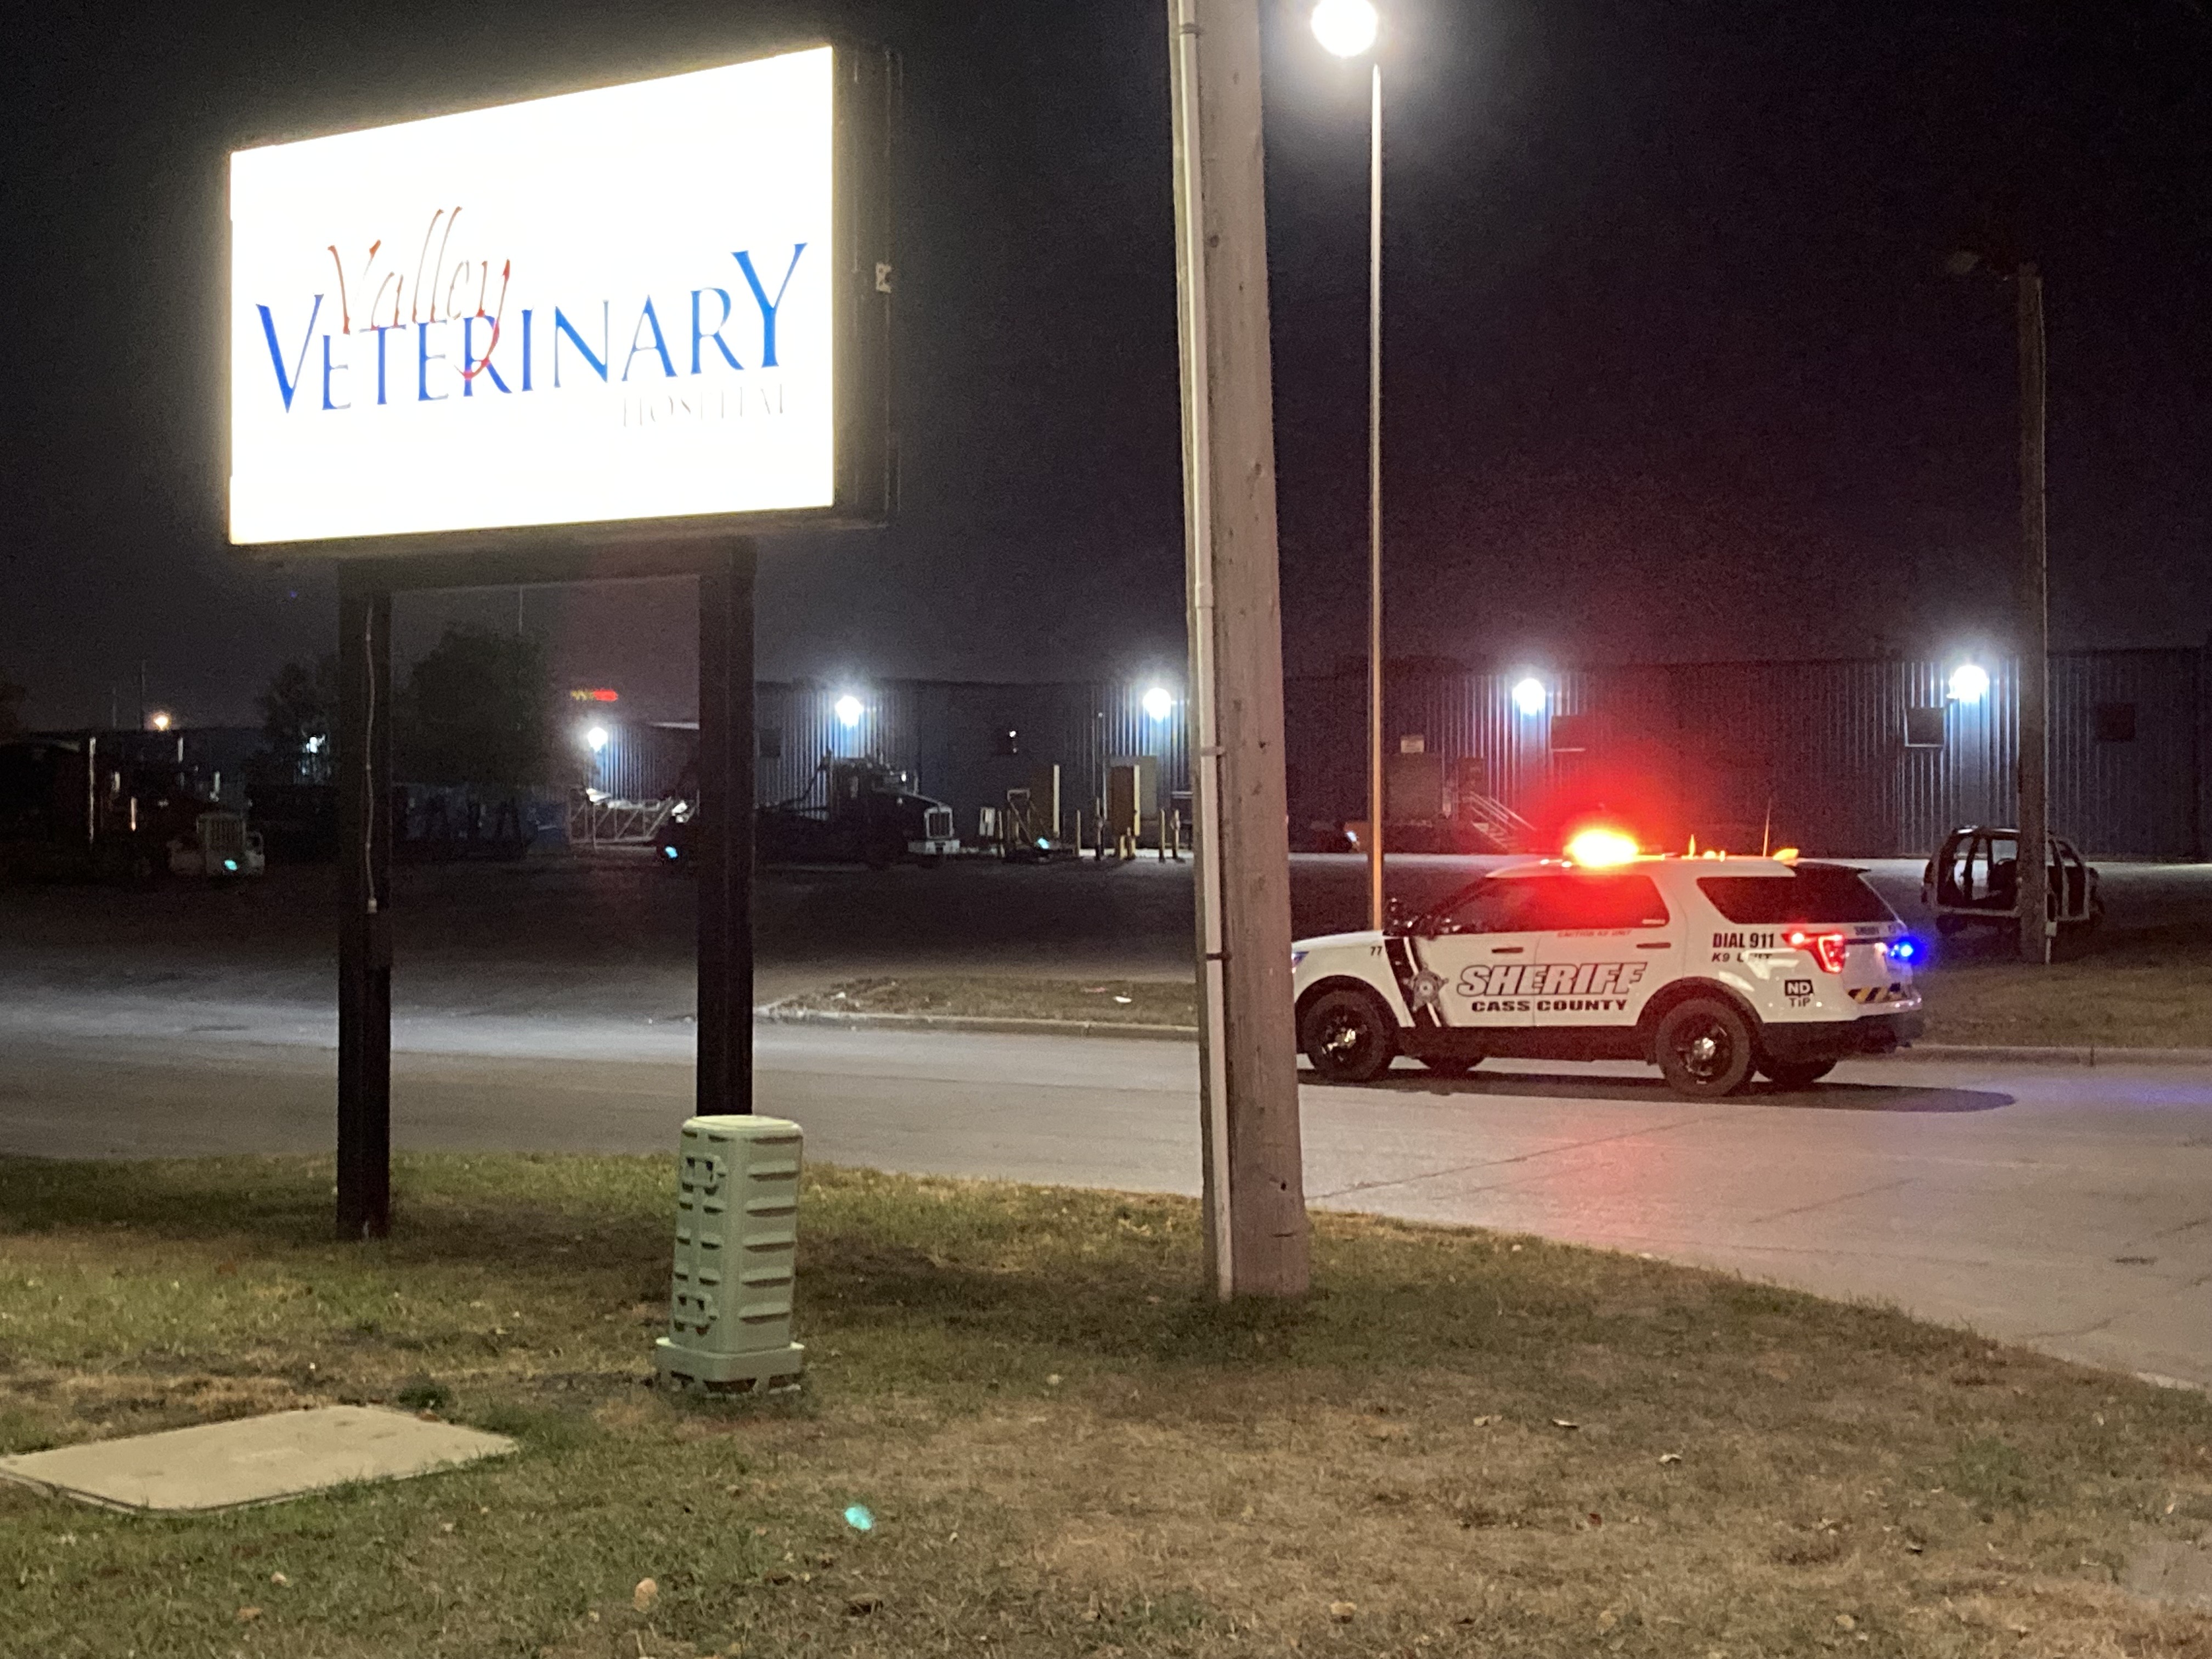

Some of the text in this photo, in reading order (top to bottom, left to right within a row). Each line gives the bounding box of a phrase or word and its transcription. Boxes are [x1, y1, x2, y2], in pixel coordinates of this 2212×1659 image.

[328, 205, 511, 377] Valley
[255, 241, 808, 414] VETERINARY
[1712, 933, 1774, 948] DIAL 911
[1370, 946, 1383, 956] 77
[1711, 952, 1730, 962] K9
[1456, 962, 1647, 997] SHERIFF
[1787, 981, 1810, 995] ND
[1471, 999, 1628, 1012] CASS COUNTY
